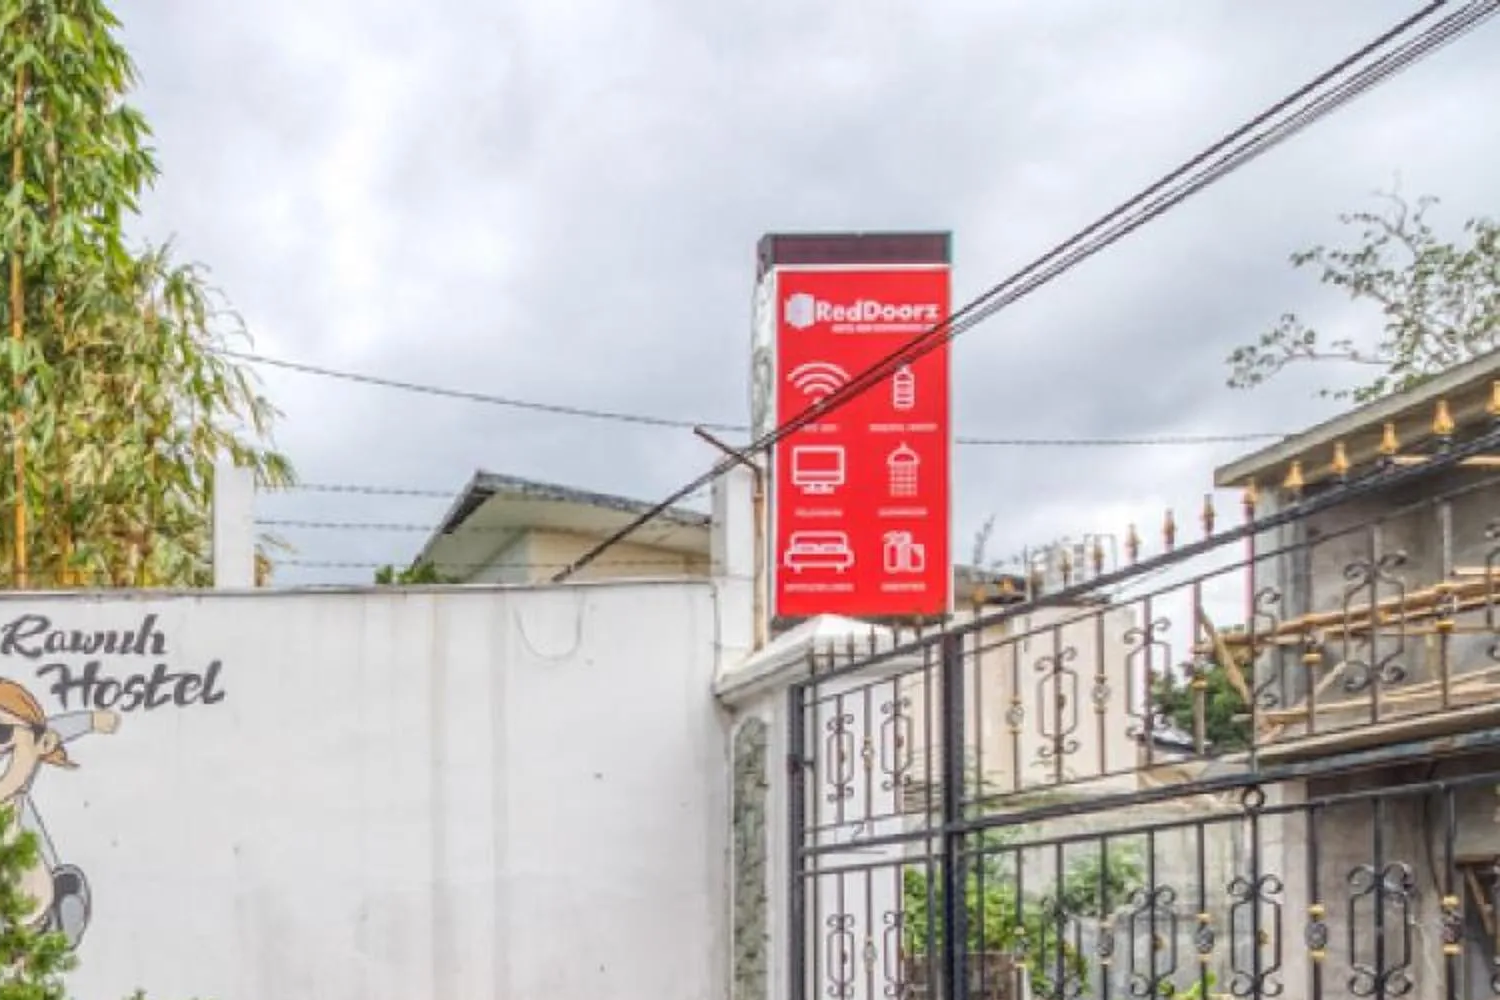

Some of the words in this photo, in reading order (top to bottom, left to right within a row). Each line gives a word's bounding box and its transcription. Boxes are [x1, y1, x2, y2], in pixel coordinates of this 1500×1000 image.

[815, 298, 941, 322] RedDoorz
[0, 613, 167, 661] Rawuh
[36, 660, 226, 712] Hostel
